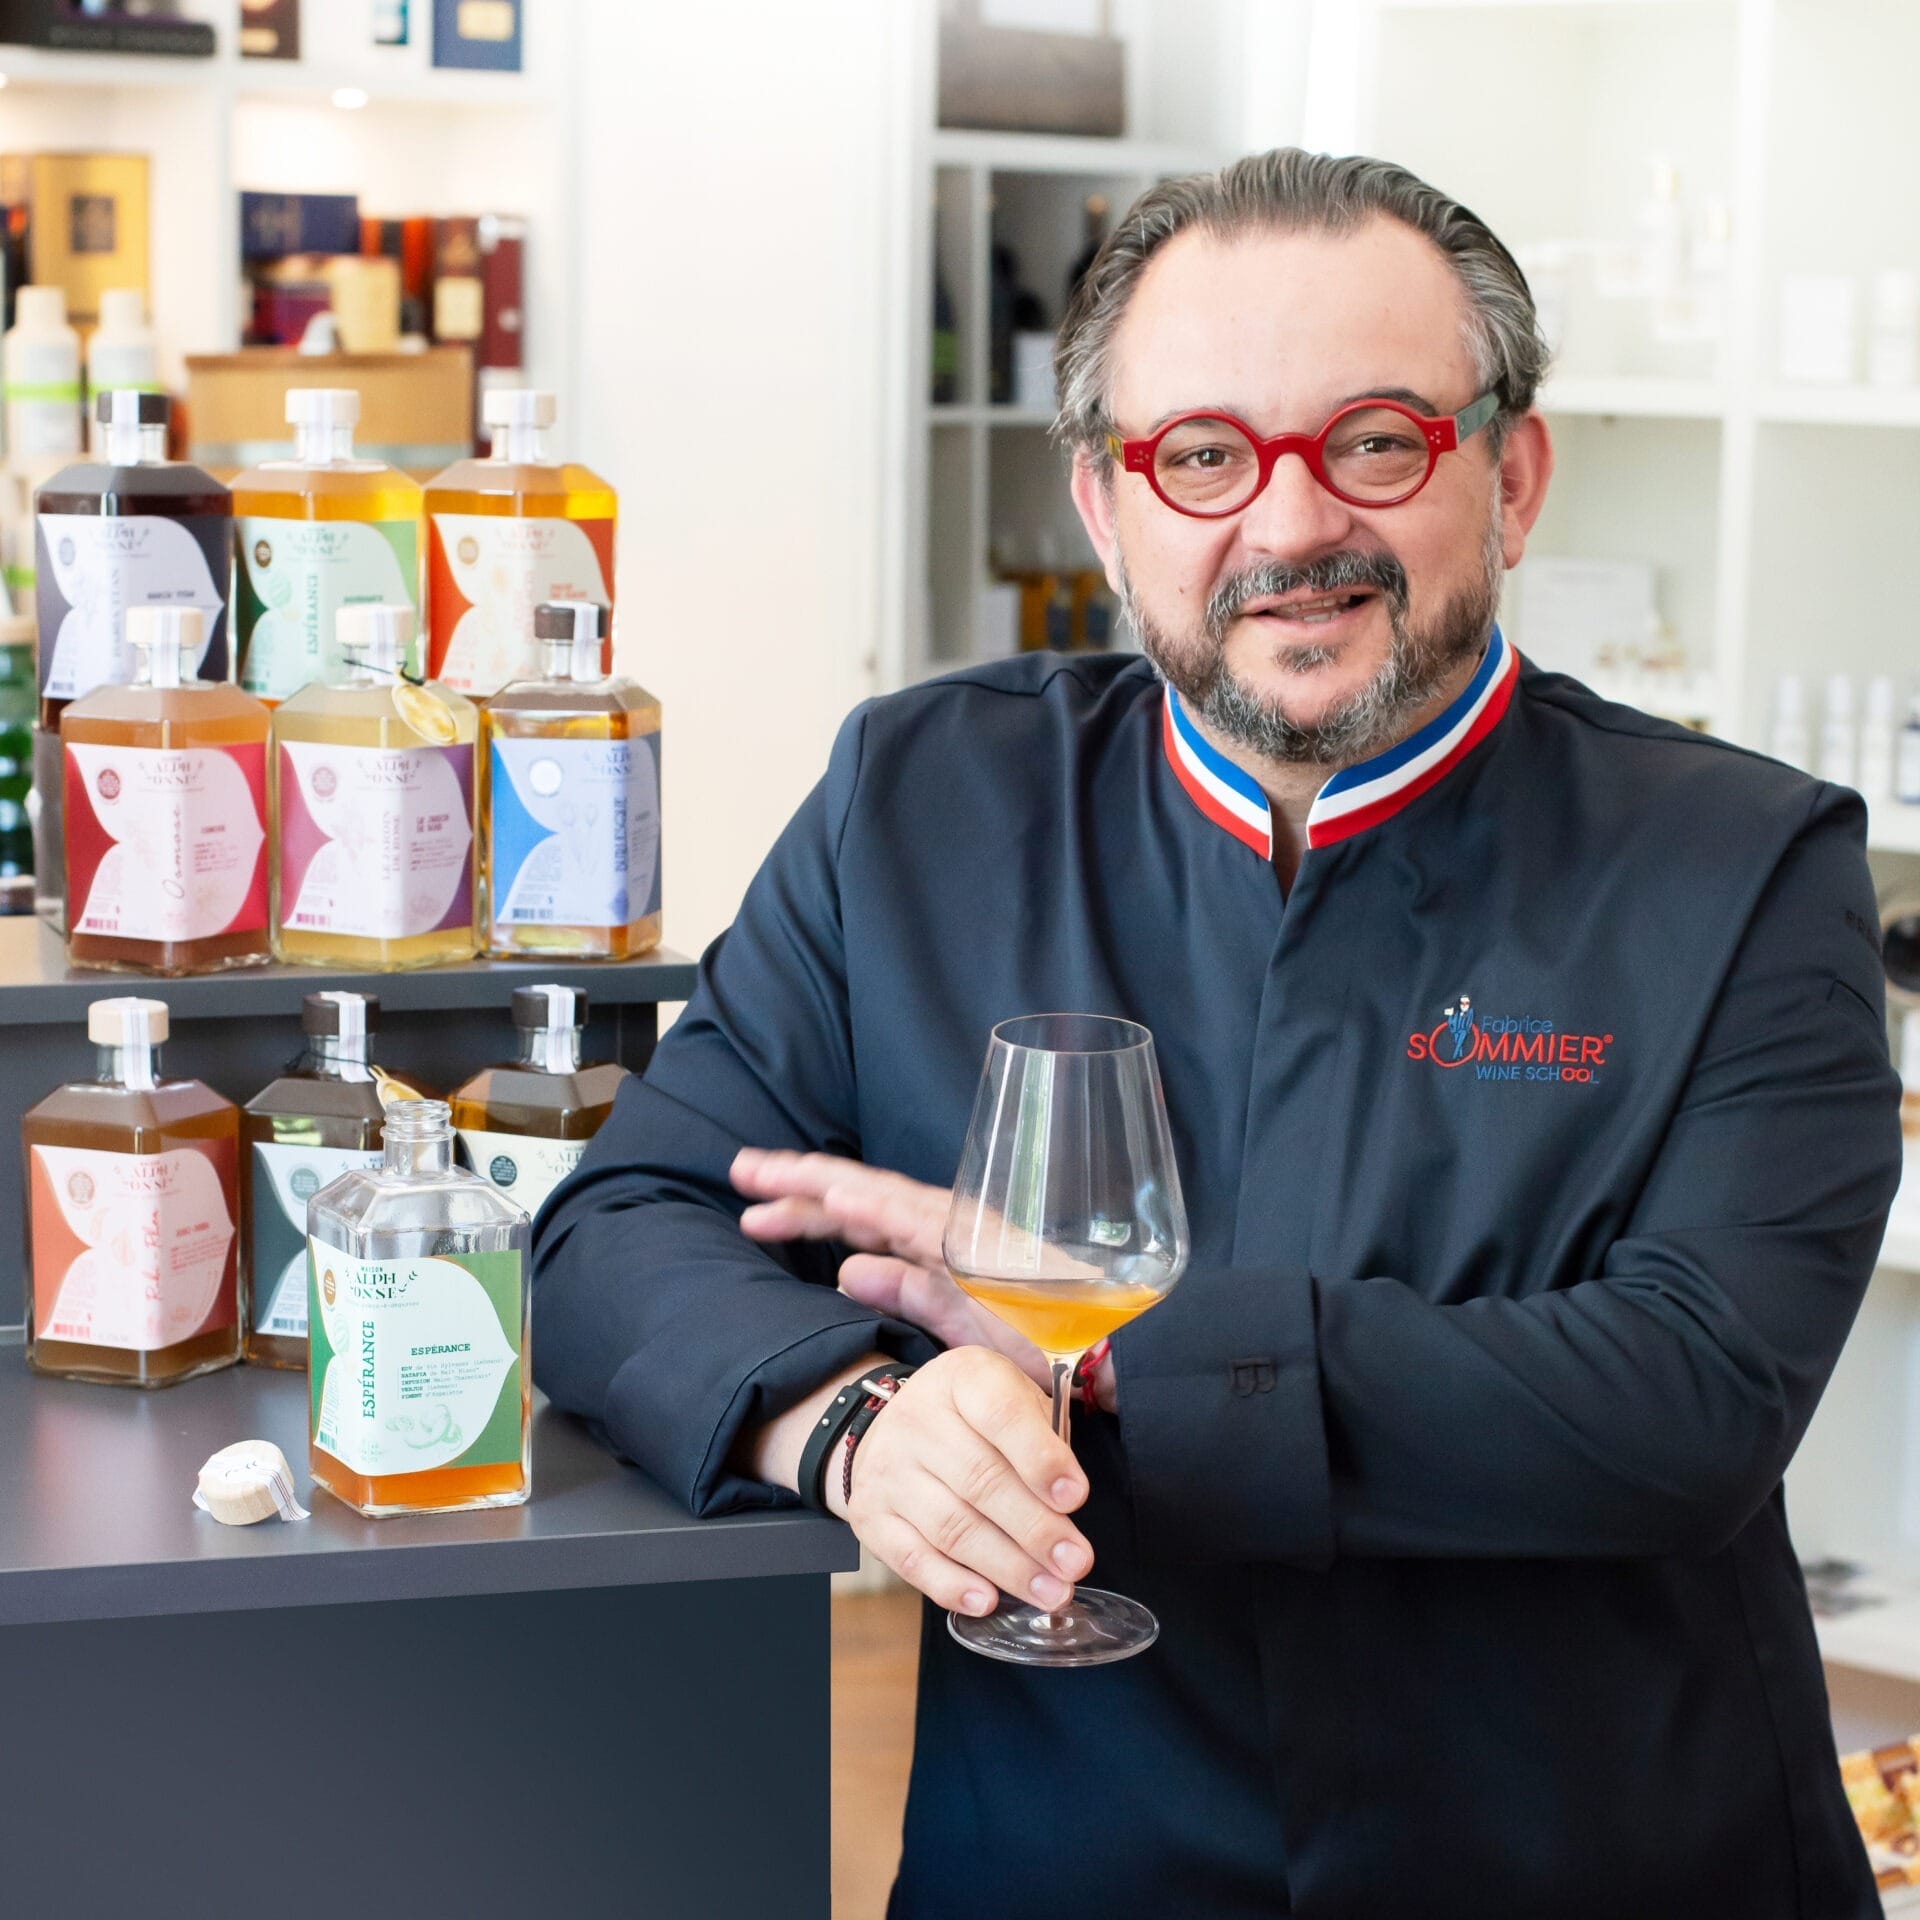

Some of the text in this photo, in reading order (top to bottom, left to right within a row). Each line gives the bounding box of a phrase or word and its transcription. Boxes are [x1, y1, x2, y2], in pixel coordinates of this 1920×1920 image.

[1481, 1015, 1553, 1034] Fabrice
[1475, 1065, 1600, 1085] WINE SCHOOL
[355, 1272, 397, 1285] ALPH
[354, 1287, 397, 1300] ONSE
[411, 1343, 471, 1356] ESPÉRANCE
[357, 1320, 375, 1419] ESPÉRANCE
